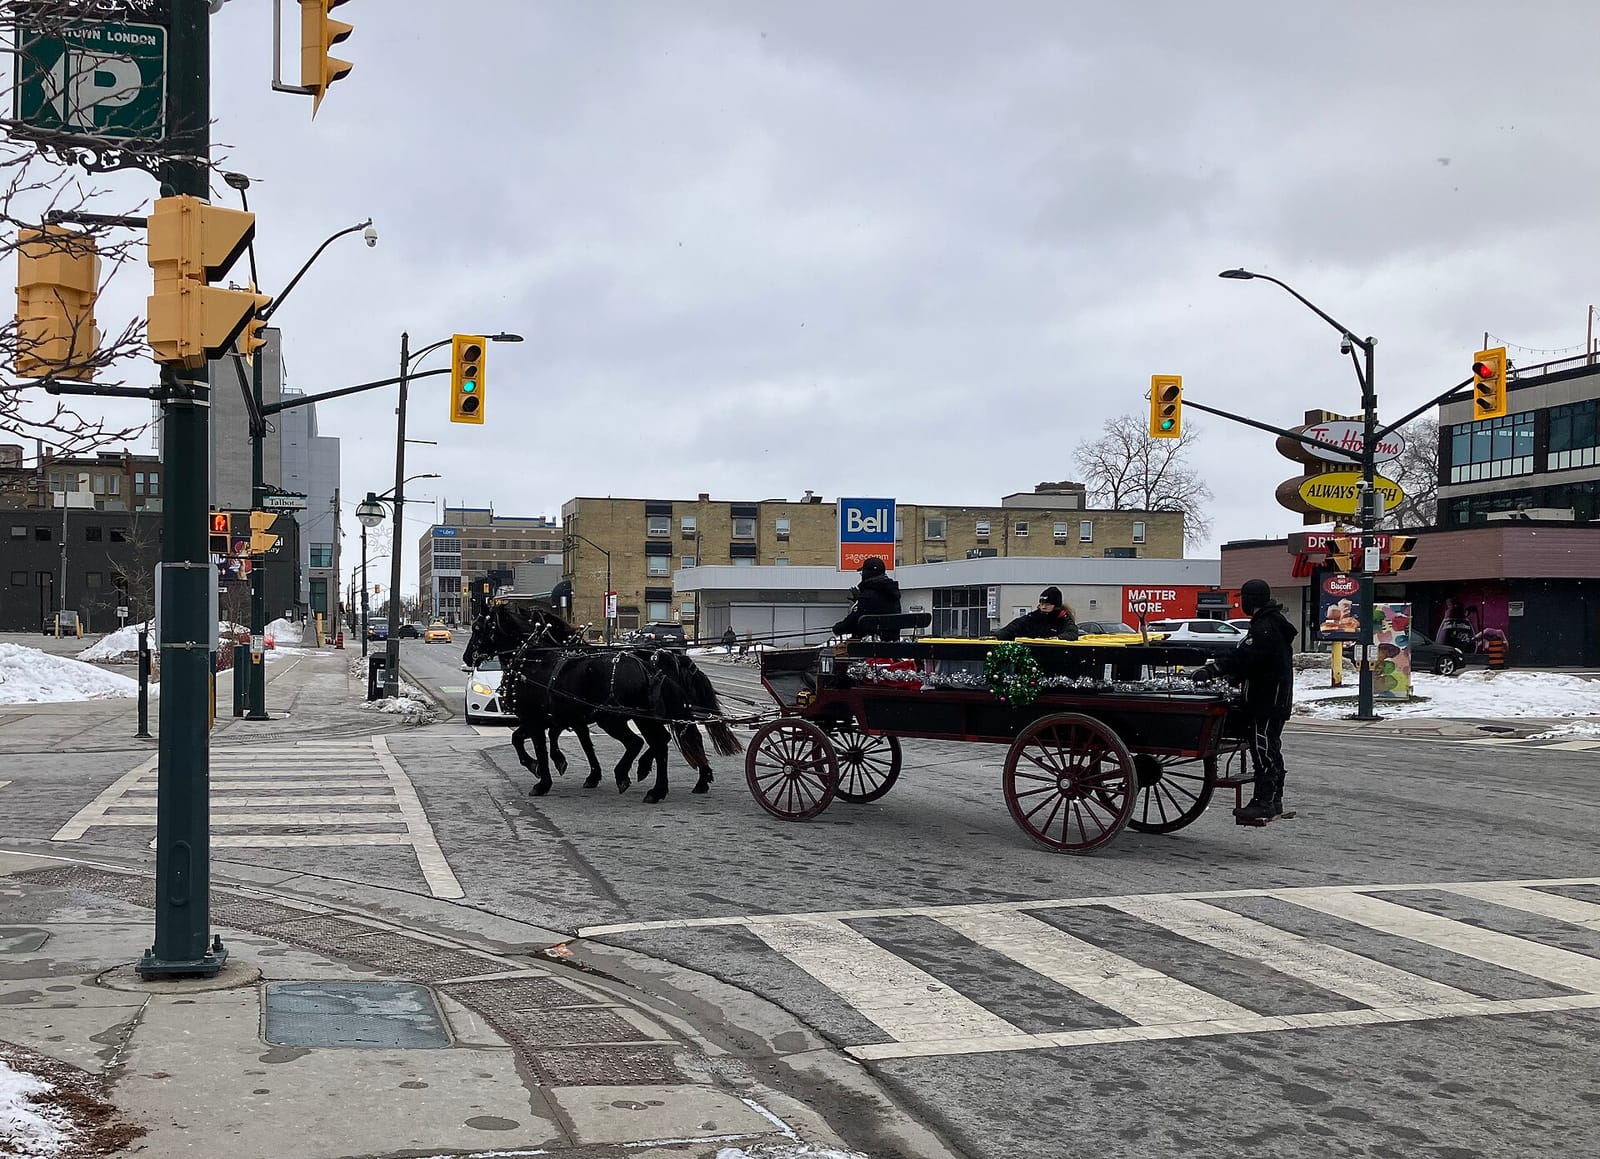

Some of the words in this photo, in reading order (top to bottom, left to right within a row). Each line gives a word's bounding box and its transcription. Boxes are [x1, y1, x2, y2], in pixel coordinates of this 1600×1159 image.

[107, 32, 156, 45] LONDON
[69, 50, 141, 128] P
[1342, 429, 1398, 455] Hoons
[1306, 484, 1355, 499] ALWAYS
[270, 498, 294, 506] Talbot
[847, 508, 888, 533] Bell
[845, 553, 889, 564] sagecomm
[1128, 590, 1176, 601] MATTER
[1128, 602, 1165, 613] MORE.
